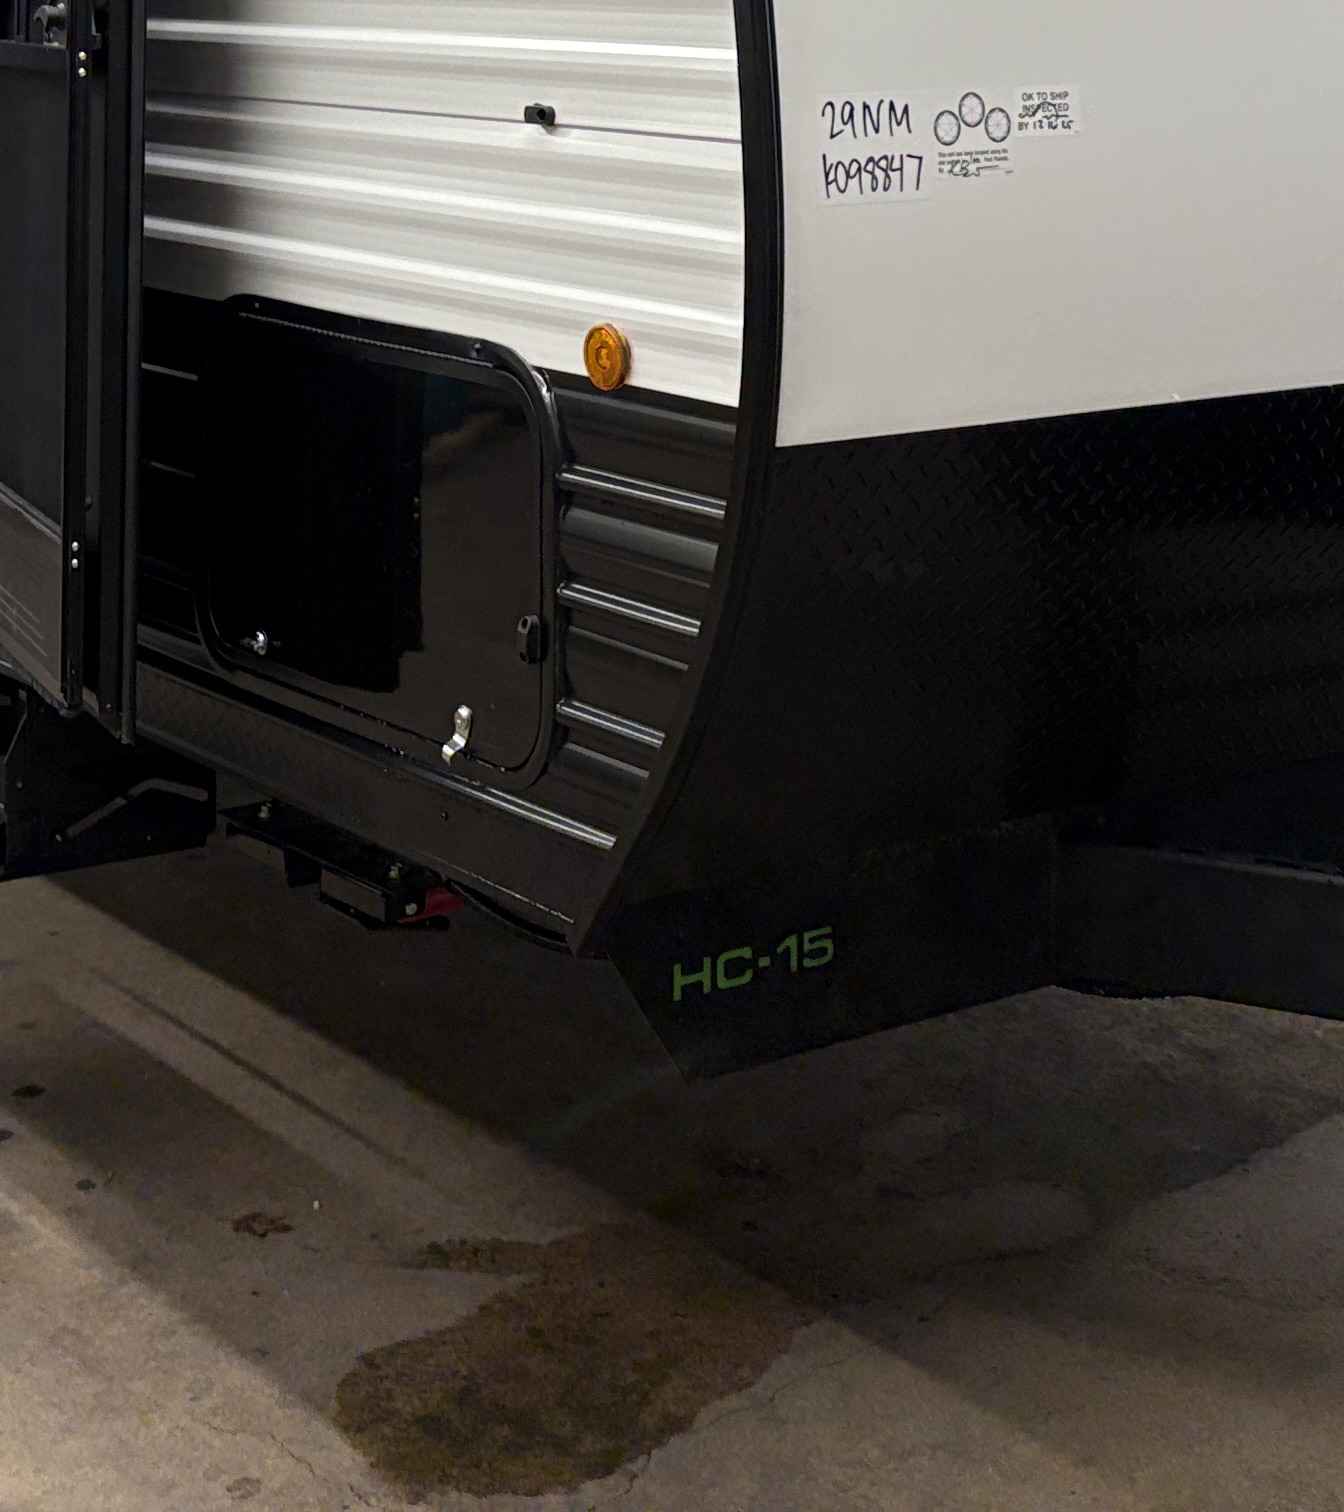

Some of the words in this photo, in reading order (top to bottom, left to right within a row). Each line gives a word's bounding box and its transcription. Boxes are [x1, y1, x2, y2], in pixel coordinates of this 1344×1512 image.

[1021, 92, 1035, 102] OK
[1036, 91, 1048, 101] TO
[1022, 102, 1069, 113] INSECED
[1018, 121, 1030, 131] BY
[672, 925, 835, 1002] HC-15
